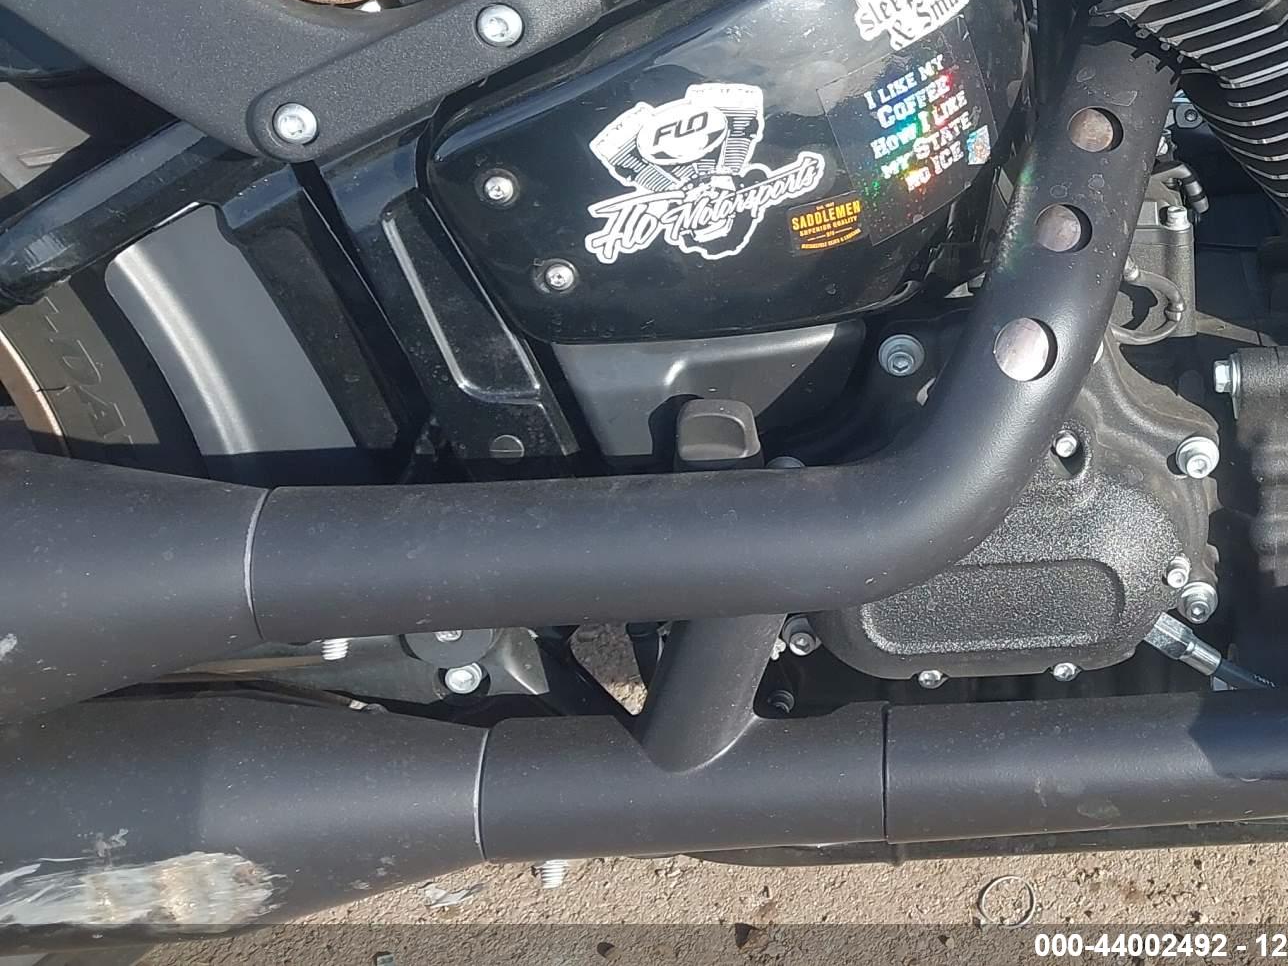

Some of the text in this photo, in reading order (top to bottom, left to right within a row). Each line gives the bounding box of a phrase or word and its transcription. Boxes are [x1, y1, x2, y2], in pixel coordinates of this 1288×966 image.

[863, 54, 945, 110] I LIKE MY
[877, 74, 951, 128] COFFEE
[652, 112, 708, 146] FLO
[870, 123, 917, 159] HOW
[931, 90, 968, 127] LIKE
[880, 112, 972, 179] MY STATE
[904, 141, 965, 191] NO ICE
[664, 153, 821, 239] Motorsports
[791, 200, 861, 231] SADDLEMEN
